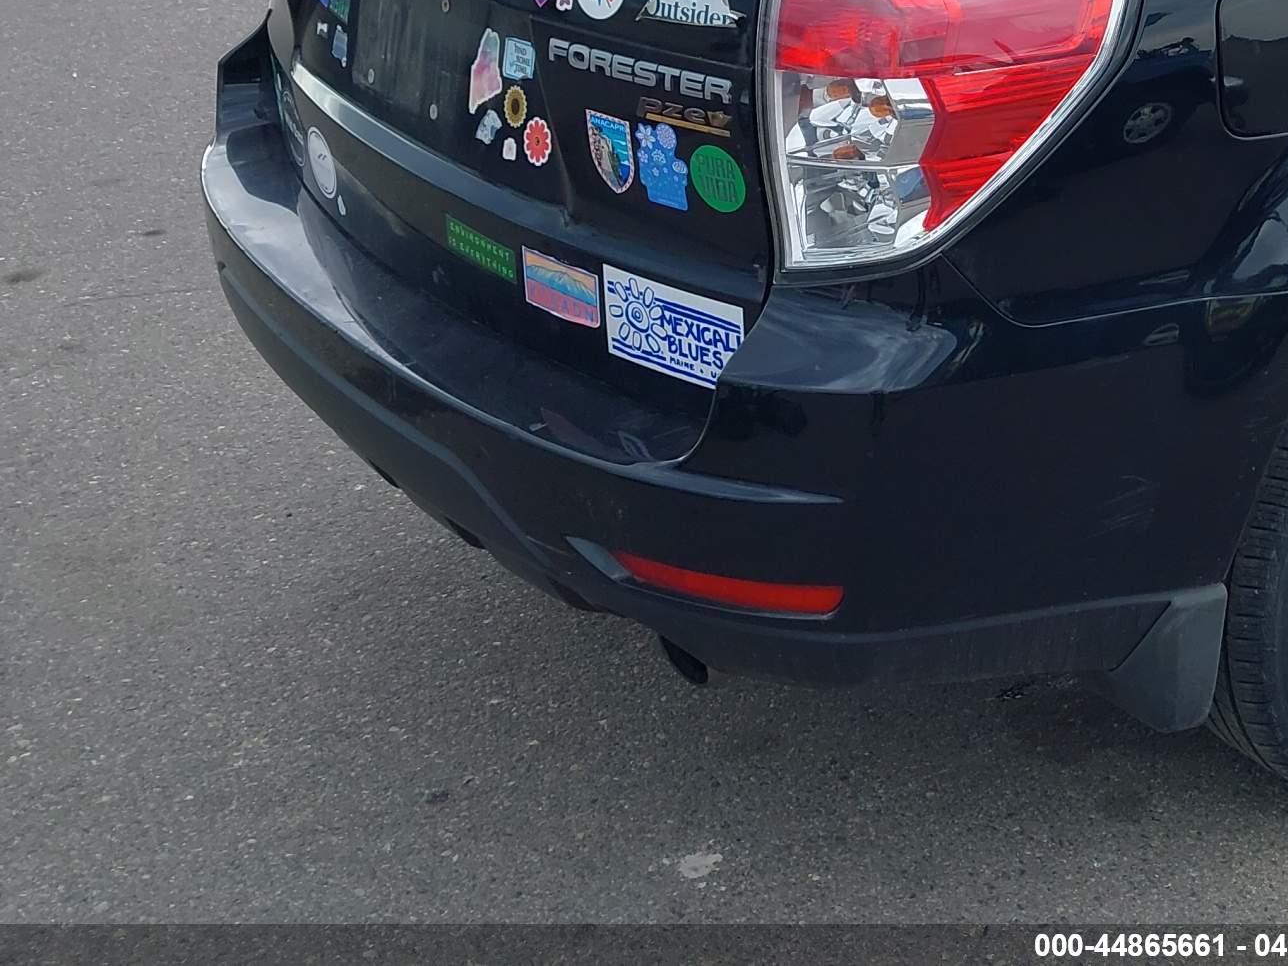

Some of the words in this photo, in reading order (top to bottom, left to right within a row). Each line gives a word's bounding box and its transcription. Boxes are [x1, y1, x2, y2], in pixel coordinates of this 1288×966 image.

[549, 37, 732, 104] FORESTER
[695, 153, 737, 181] PURA
[450, 221, 509, 262] ENVIRONMENT
[460, 242, 514, 278] EVERYTHING
[667, 335, 724, 370] BLUES
[669, 356, 695, 371] MAINE
